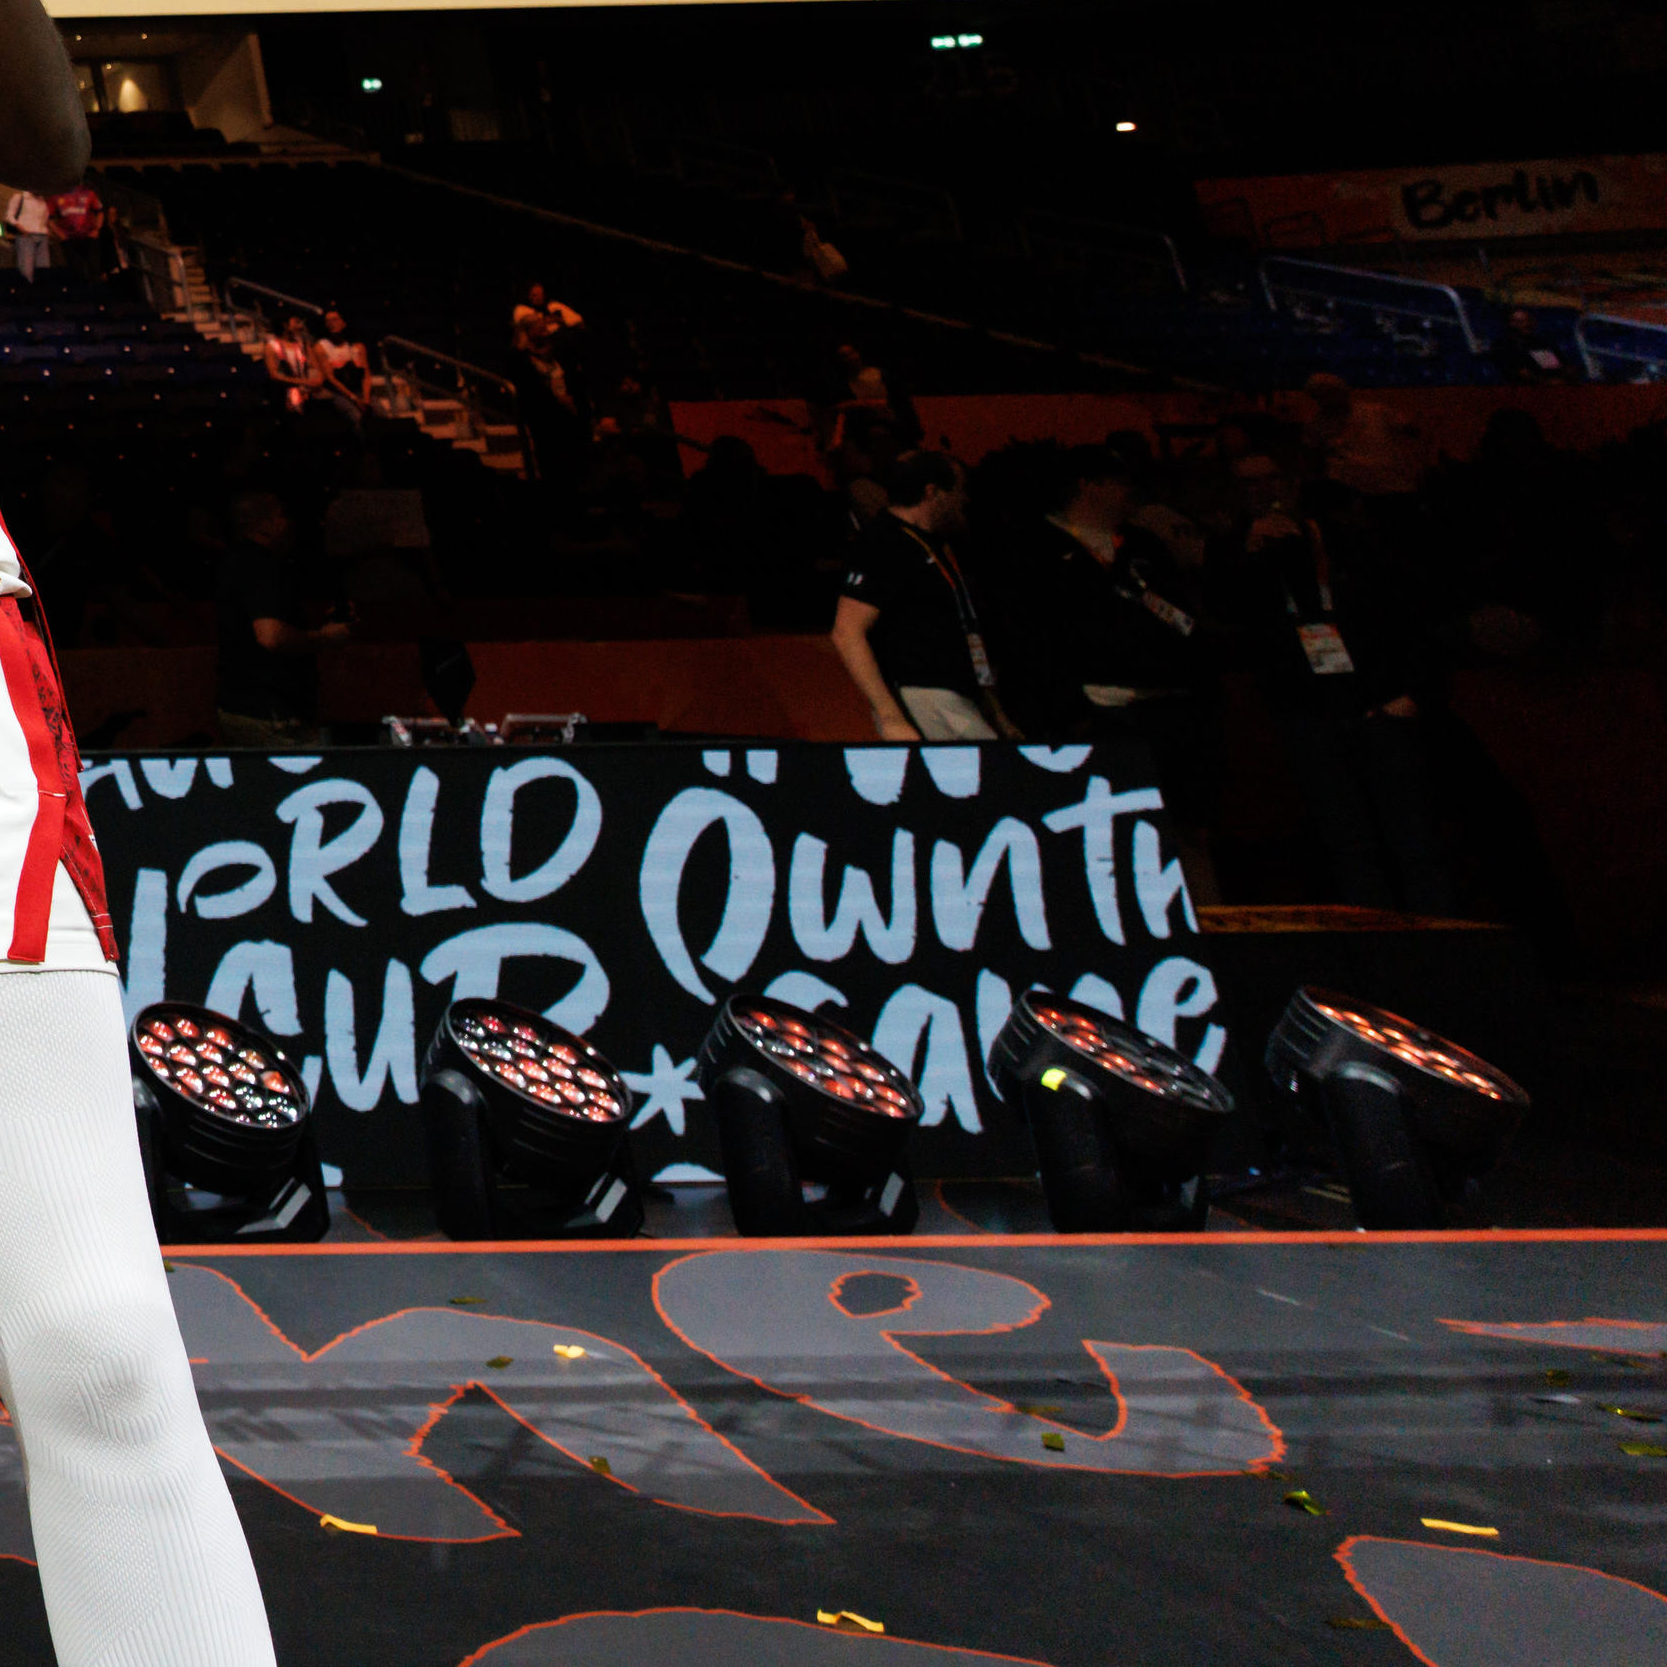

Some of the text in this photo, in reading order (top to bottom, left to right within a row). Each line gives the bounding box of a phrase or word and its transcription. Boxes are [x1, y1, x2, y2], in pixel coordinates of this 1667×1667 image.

[1401, 169, 1599, 229] Berlin
[640, 775, 1199, 1006] Own th
